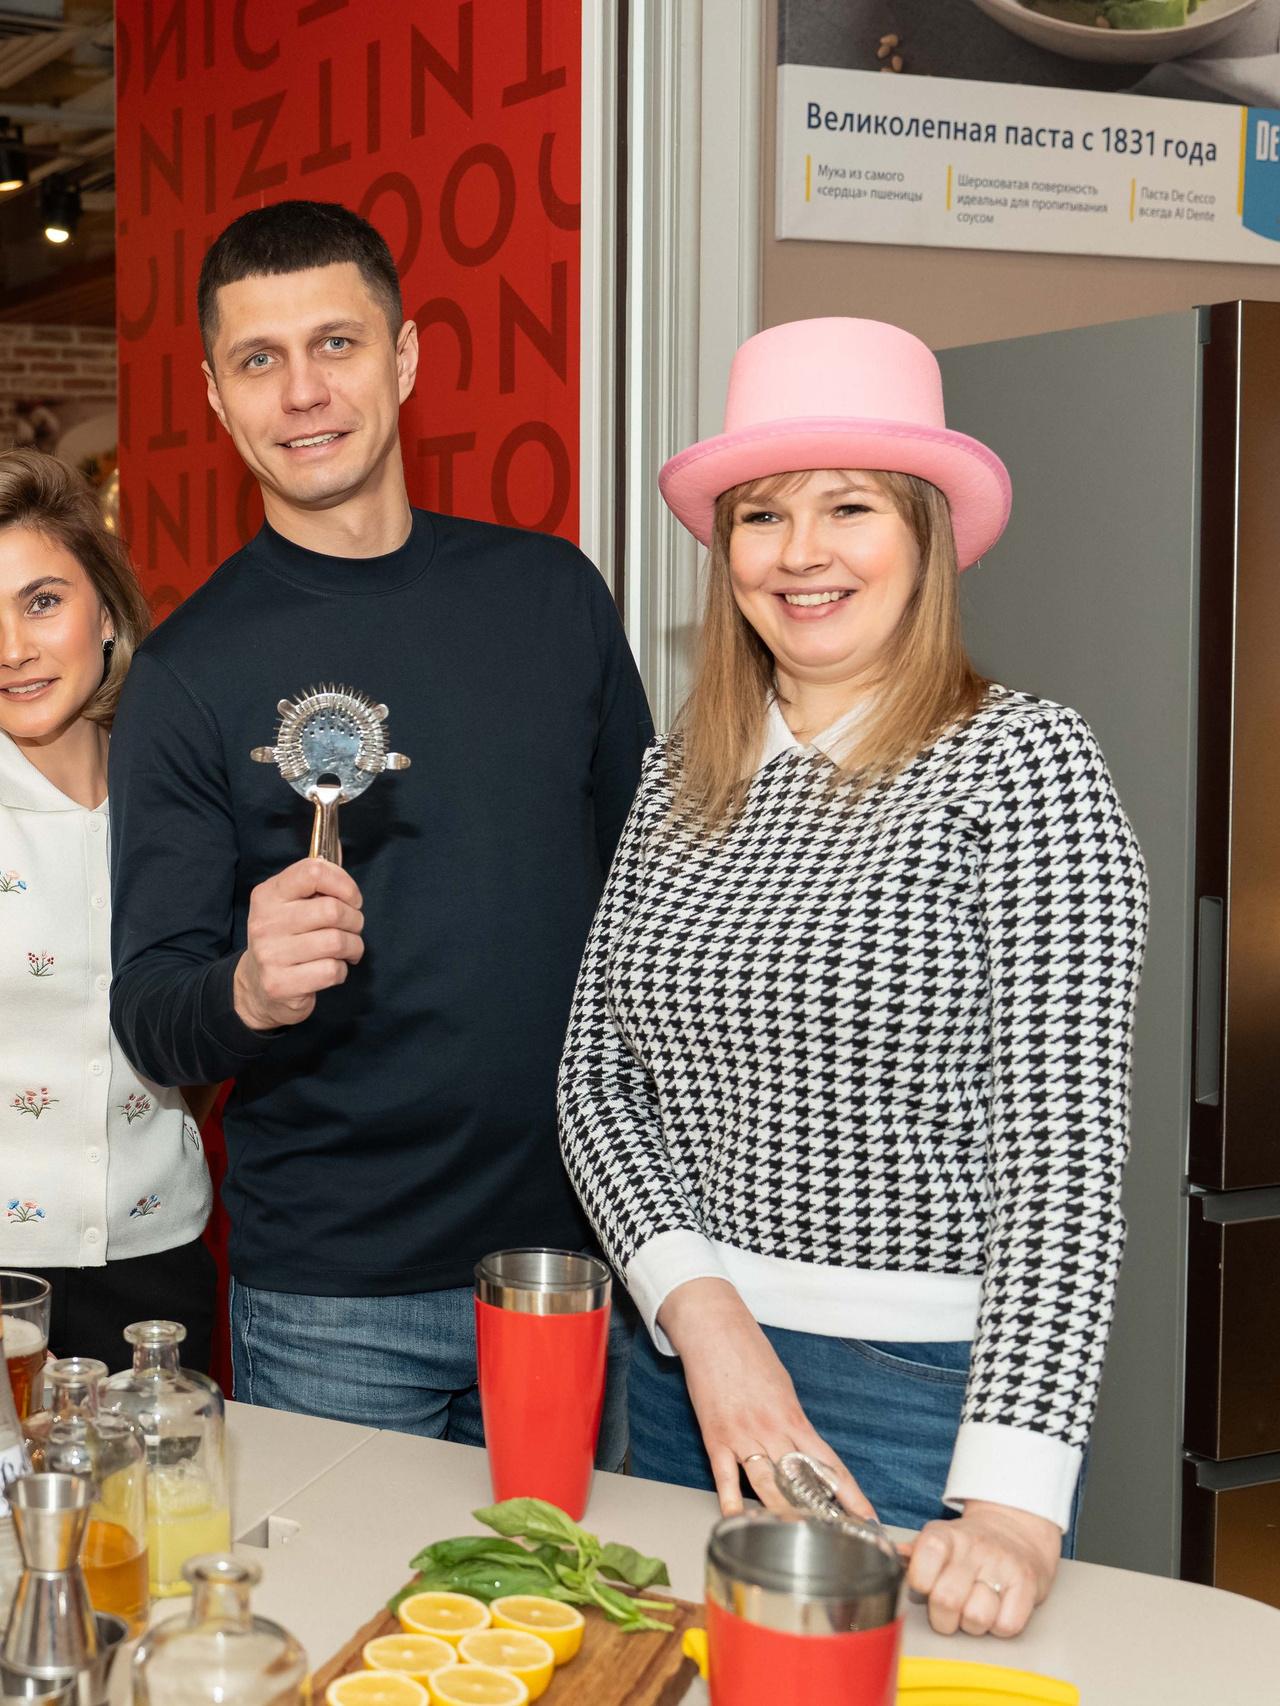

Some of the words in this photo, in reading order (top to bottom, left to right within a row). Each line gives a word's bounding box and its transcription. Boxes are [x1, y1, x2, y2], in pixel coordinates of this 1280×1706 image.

[807, 102, 997, 143] Великолепная
[1005, 125, 1074, 149] паста
[1082, 131, 1094, 151] с
[1102, 126, 1156, 156] 1831
[1163, 138, 1218, 166] года
[1255, 119, 1280, 162] DE
[817, 164, 847, 180] Мука
[849, 169, 862, 180] из
[864, 170, 905, 182] самого
[817, 185, 867, 199] «сердца»
[870, 189, 923, 202] пшеницы
[957, 174, 1029, 191] Шероховатая
[1031, 180, 1099, 196] поверхность
[957, 194, 1009, 209] идеальна
[1010, 198, 1029, 209] для
[1031, 199, 1108, 214] пропитывания
[1141, 186, 1168, 201] Паста
[1171, 190, 1185, 202] De
[1187, 190, 1216, 205] Cecco
[956, 212, 994, 225] соусом
[1139, 207, 1172, 219] всегда
[1187, 208, 1216, 222] Dente
